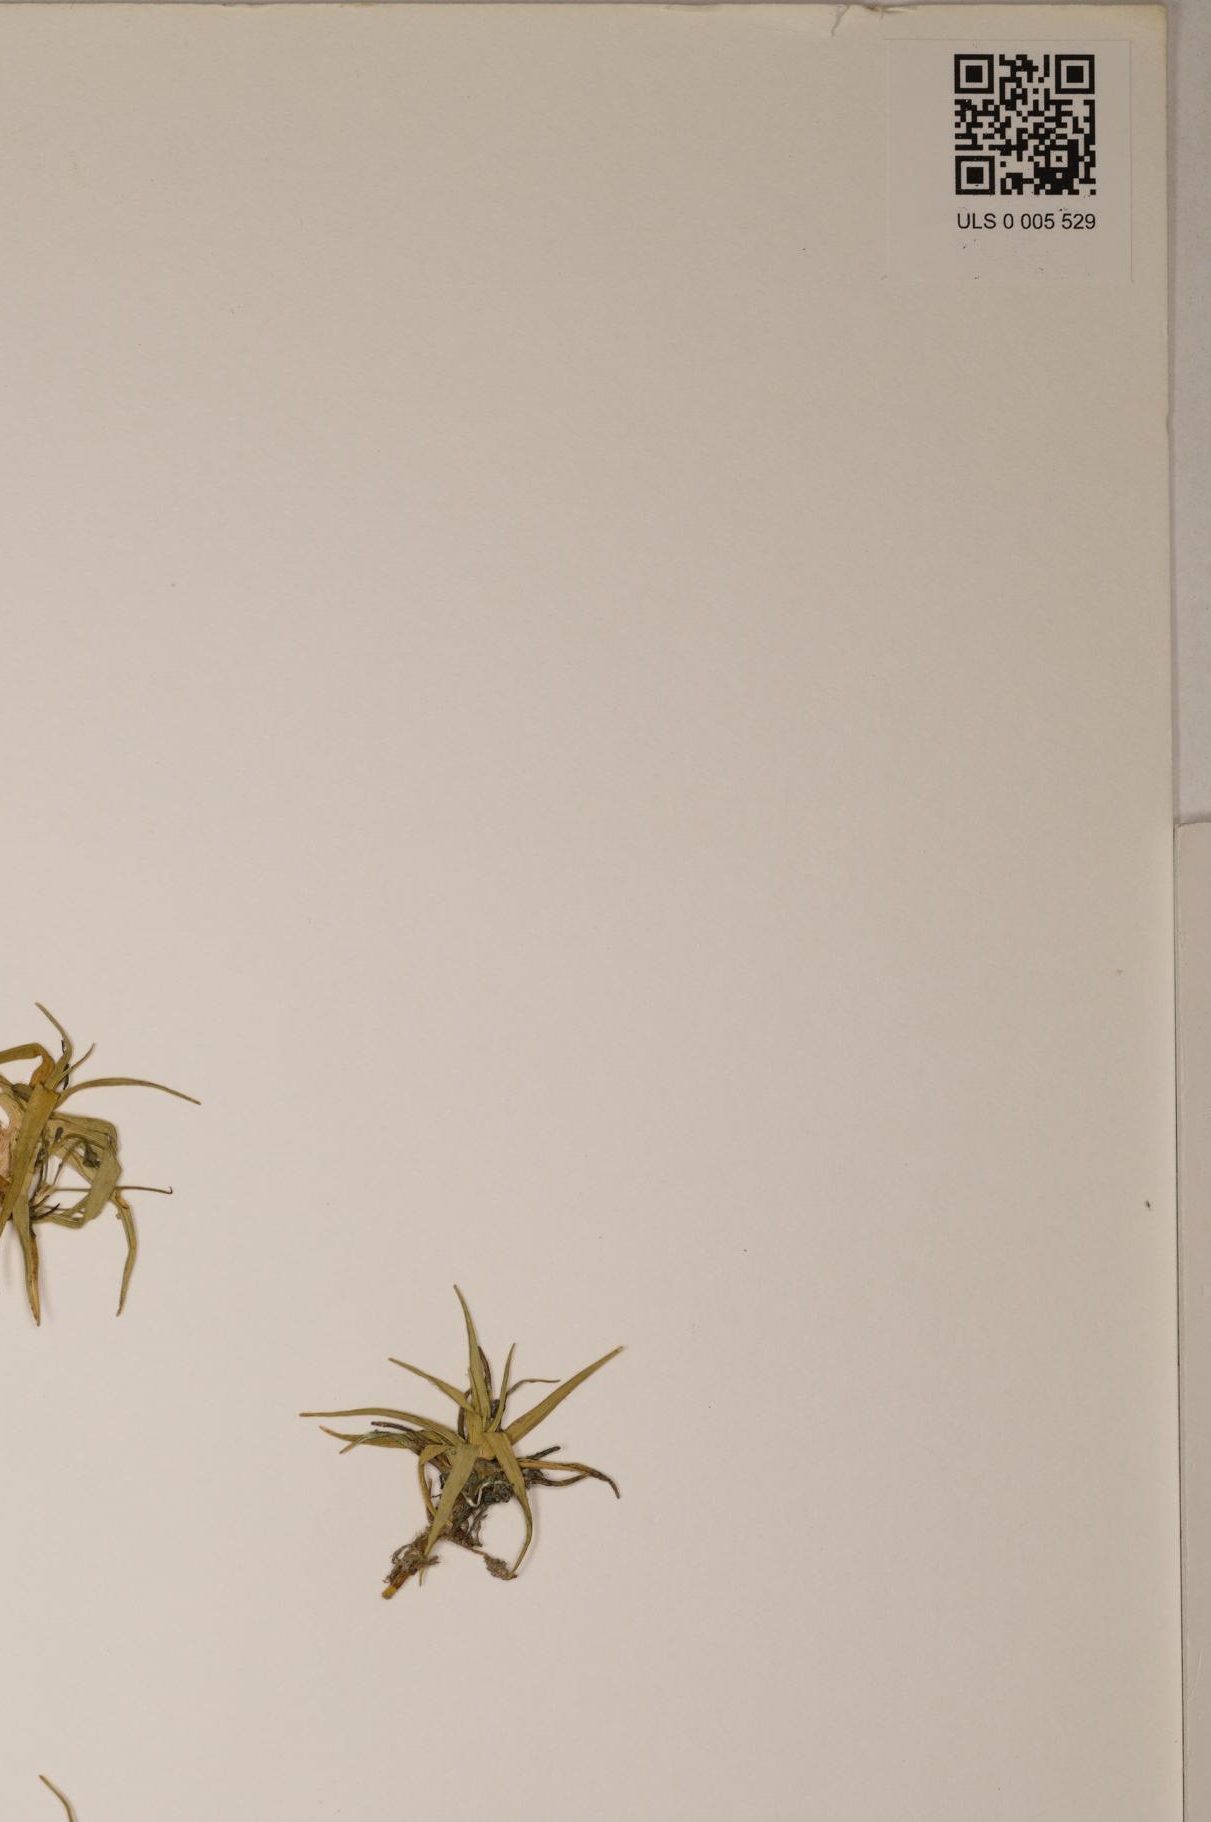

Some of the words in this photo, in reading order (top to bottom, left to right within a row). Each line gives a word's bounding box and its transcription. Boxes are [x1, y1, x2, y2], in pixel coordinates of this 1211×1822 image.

[956, 212, 997, 230] ULS
[1002, 213, 1014, 230] 0
[1020, 212, 1056, 230] 005
[1061, 212, 1096, 230] 529
